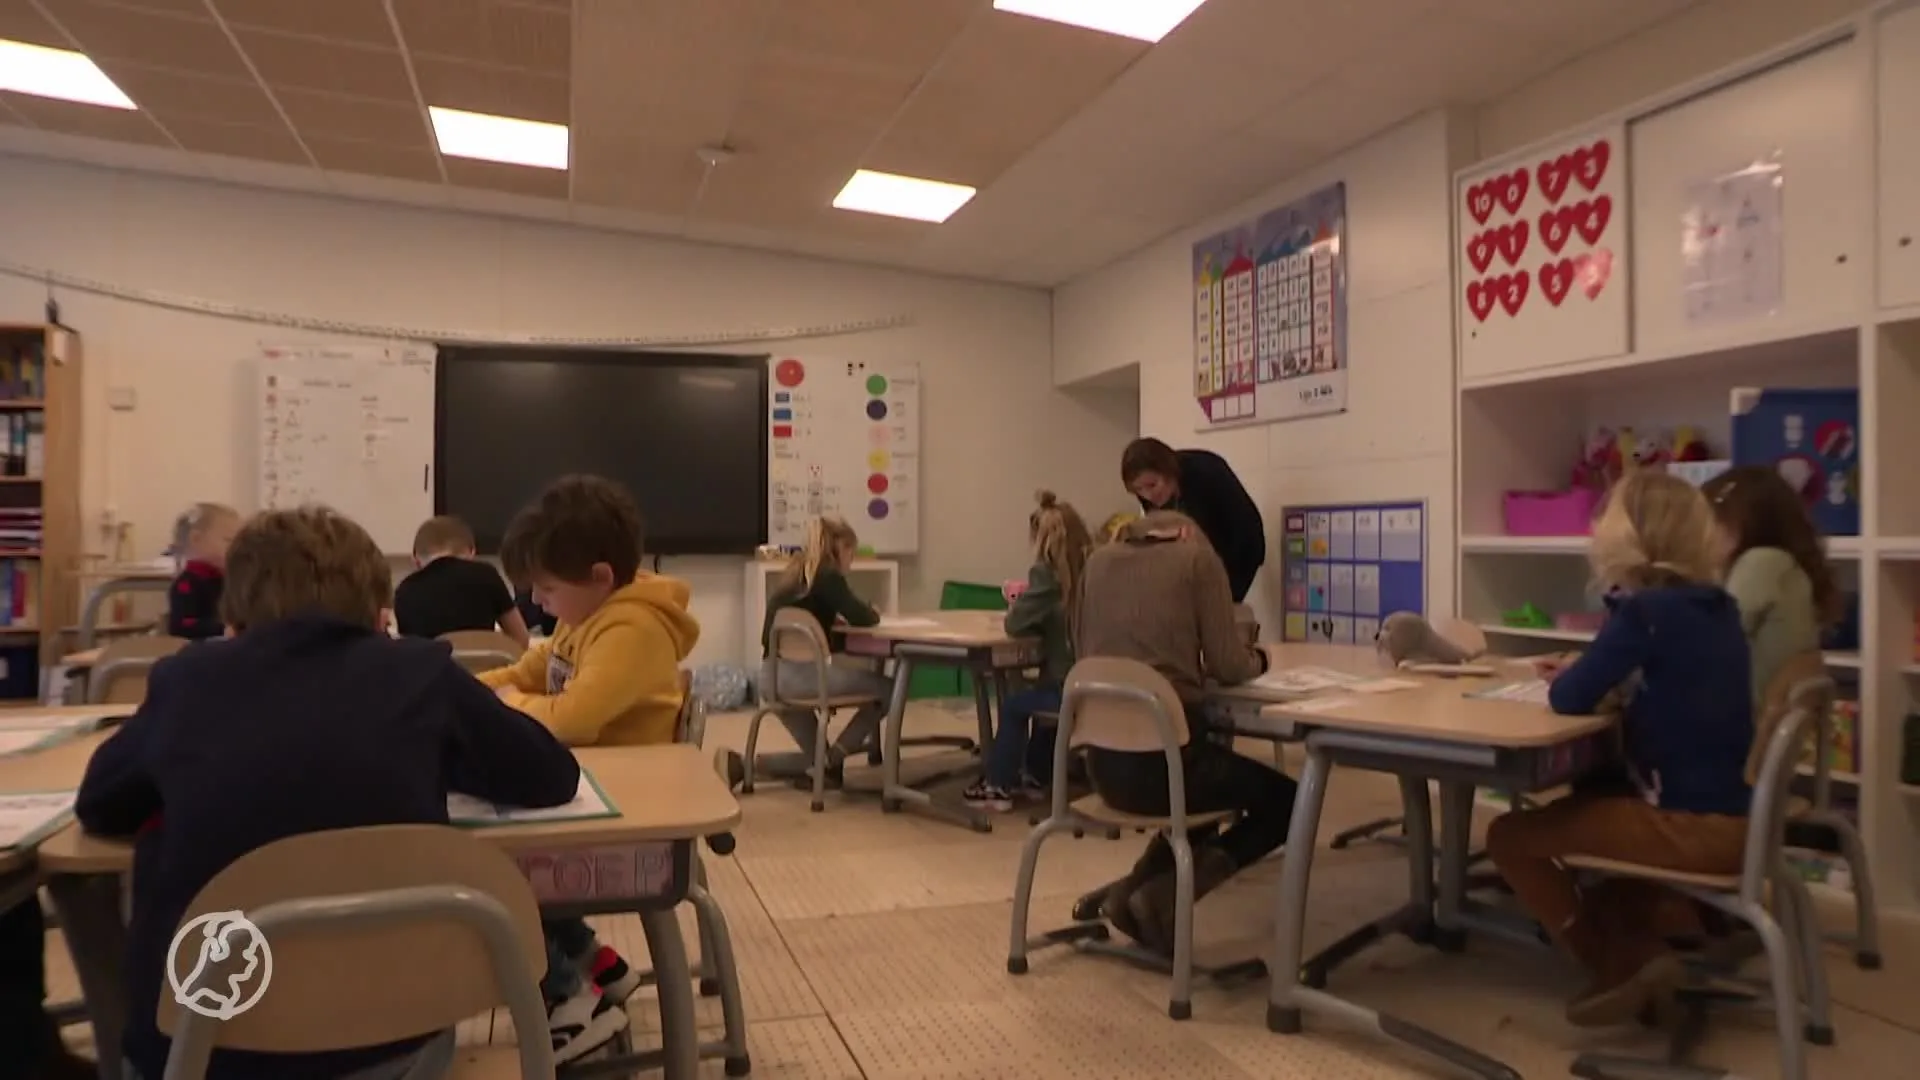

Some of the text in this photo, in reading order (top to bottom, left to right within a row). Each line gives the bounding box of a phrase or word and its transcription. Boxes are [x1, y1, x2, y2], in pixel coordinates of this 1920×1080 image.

[1549, 171, 1560, 192] 7
[1474, 184, 1519, 214] 10 0
[1549, 211, 1599, 242] 6 4
[1476, 242, 1487, 261] 9
[1508, 283, 1519, 304] 2
[1551, 272, 1562, 294] 5
